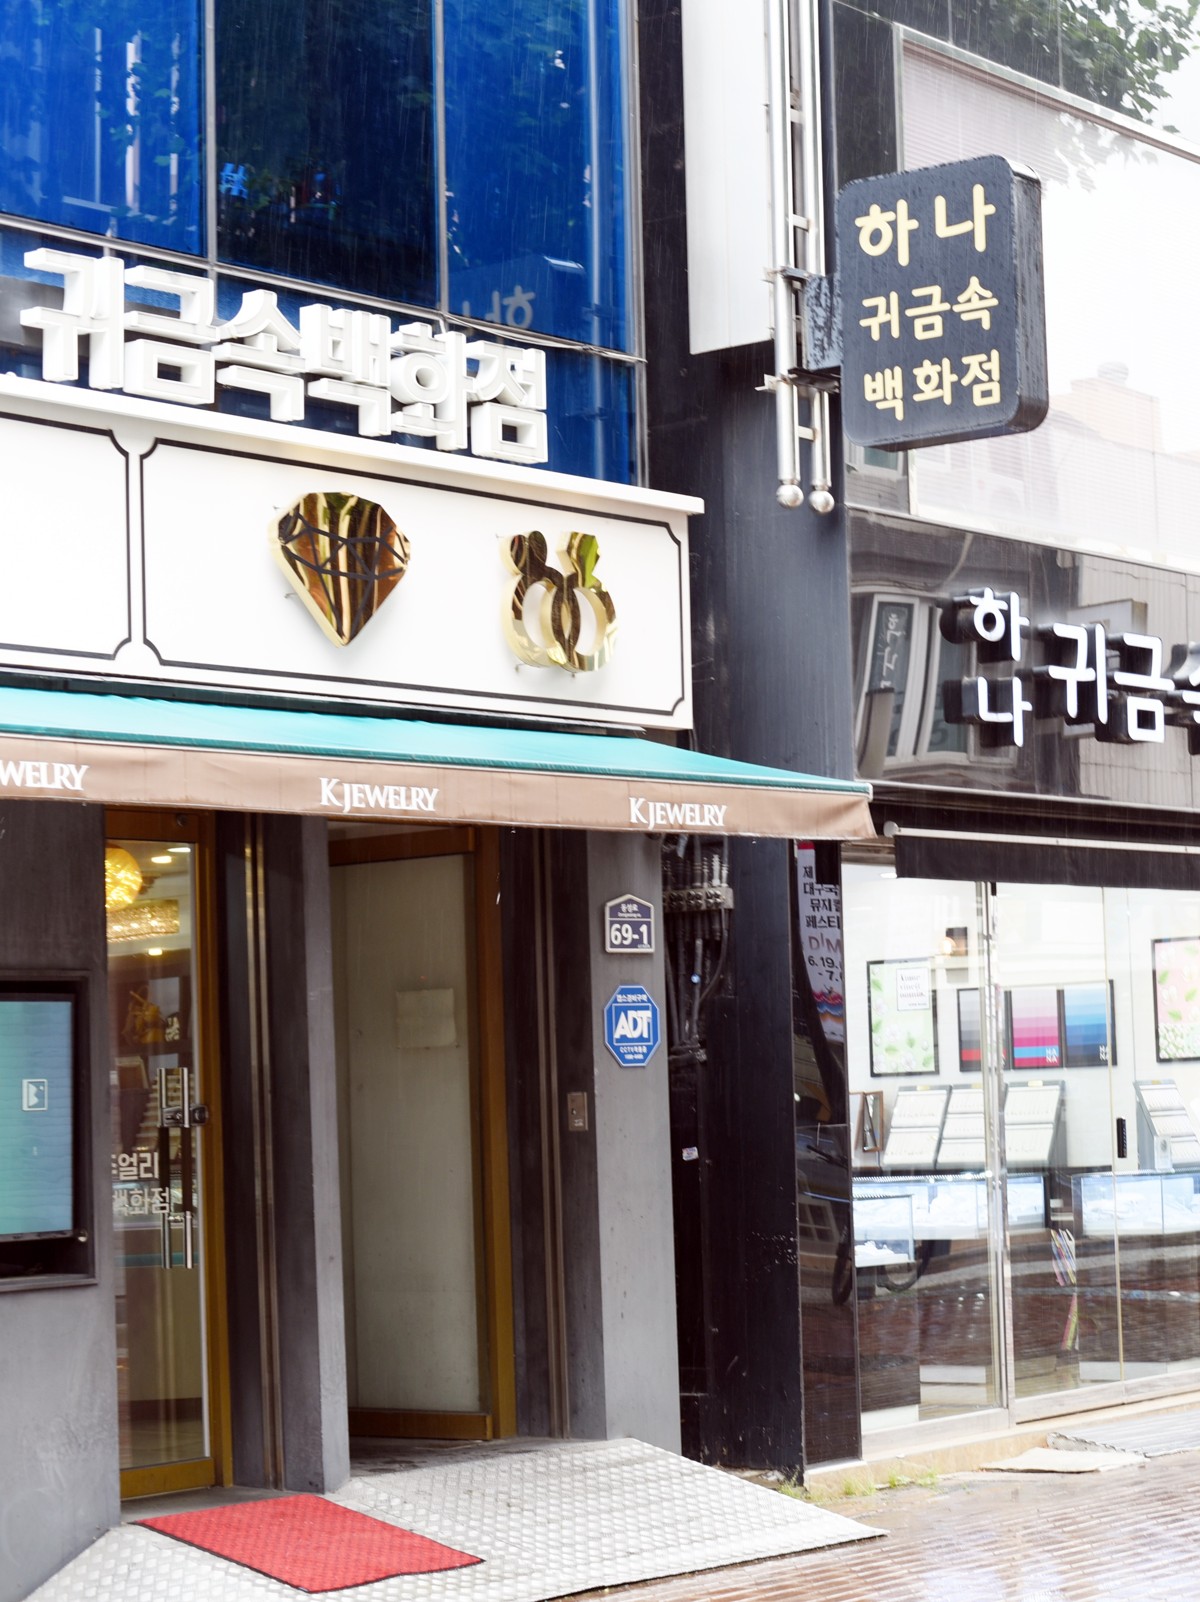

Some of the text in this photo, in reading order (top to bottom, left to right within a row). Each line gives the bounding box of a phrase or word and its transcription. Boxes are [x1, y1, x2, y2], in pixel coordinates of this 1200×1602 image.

[855, 183, 996, 266] 하나
[859, 275, 999, 341] 귀금속
[19, 247, 549, 464] 귀금속백화점
[863, 349, 1001, 421] 백화점
[610, 923, 649, 946] 69-1
[614, 1009, 652, 1039] ADT
[111, 1152, 160, 1181] 얼리
